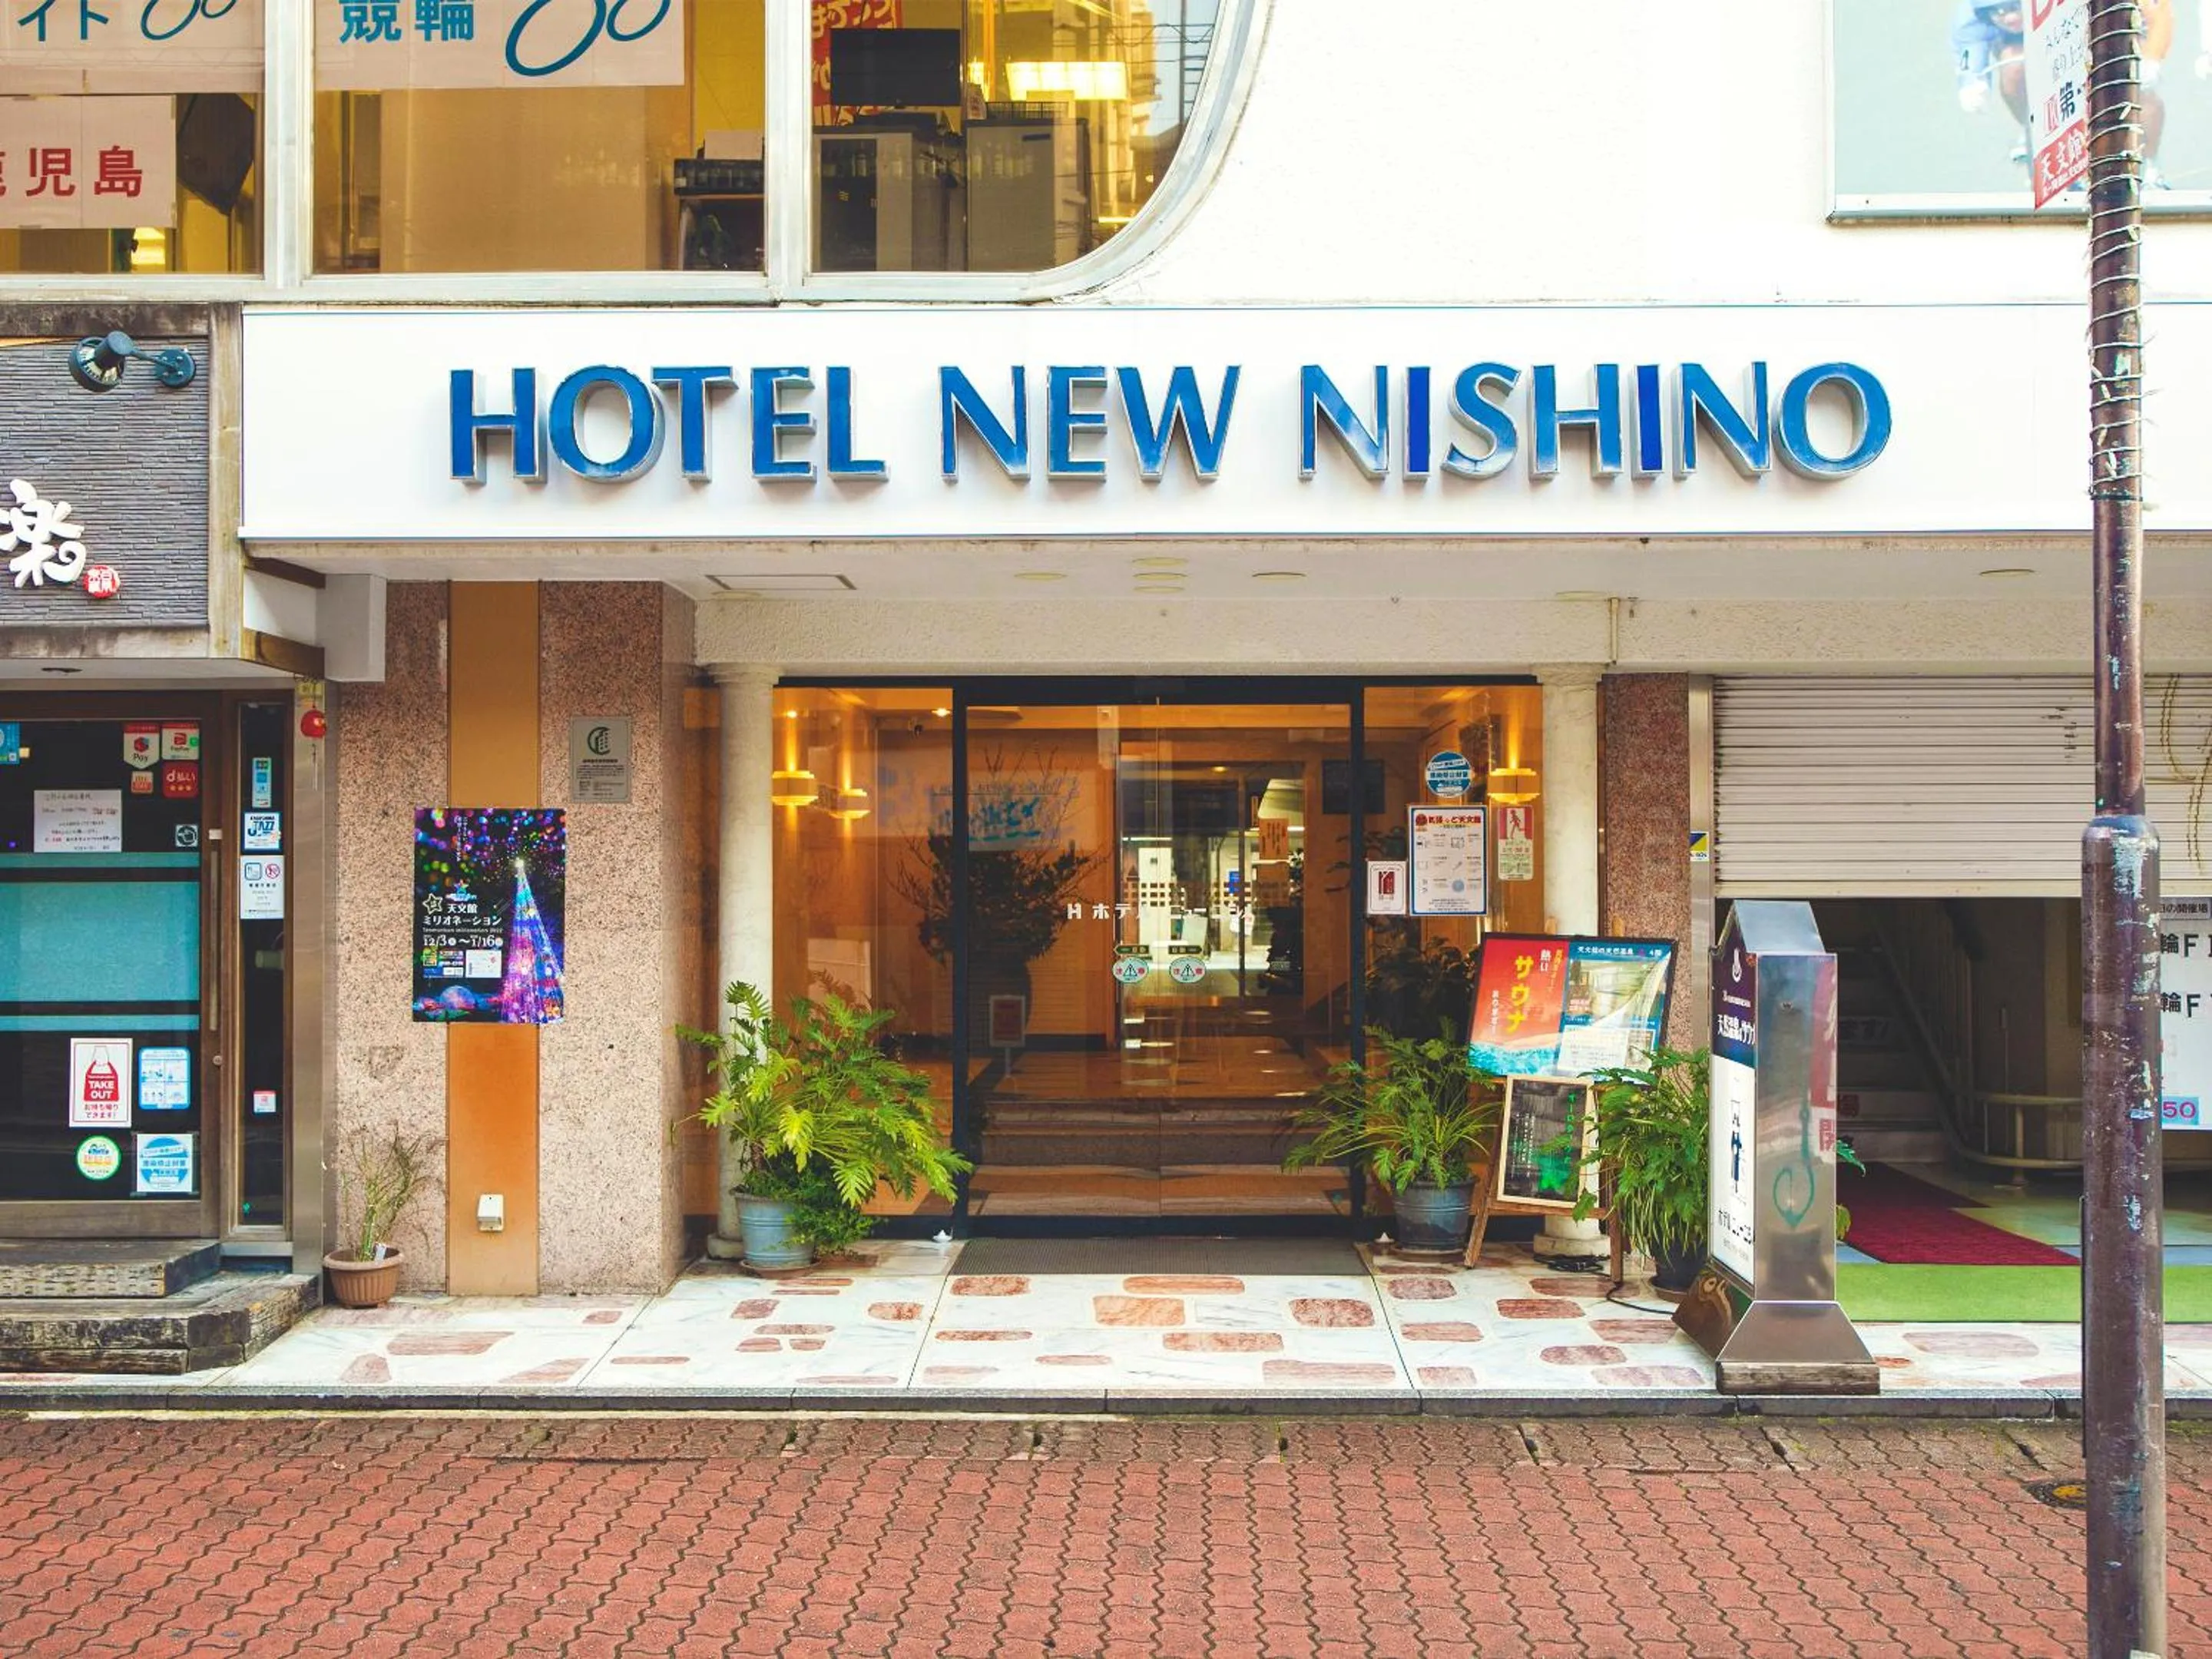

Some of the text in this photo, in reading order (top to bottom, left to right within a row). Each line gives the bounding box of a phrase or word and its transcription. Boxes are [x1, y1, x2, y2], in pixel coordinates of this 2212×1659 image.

[0, 145, 143, 197] 児島
[449, 361, 1892, 485] HOTEL NEW NISHINO
[447, 903, 478, 914] 天文館
[422, 915, 502, 926] ミリオネーション
[1507, 955, 1535, 1035] サウナ
[88, 1080, 114, 1089] TAKE
[91, 1091, 113, 1100] OUT
